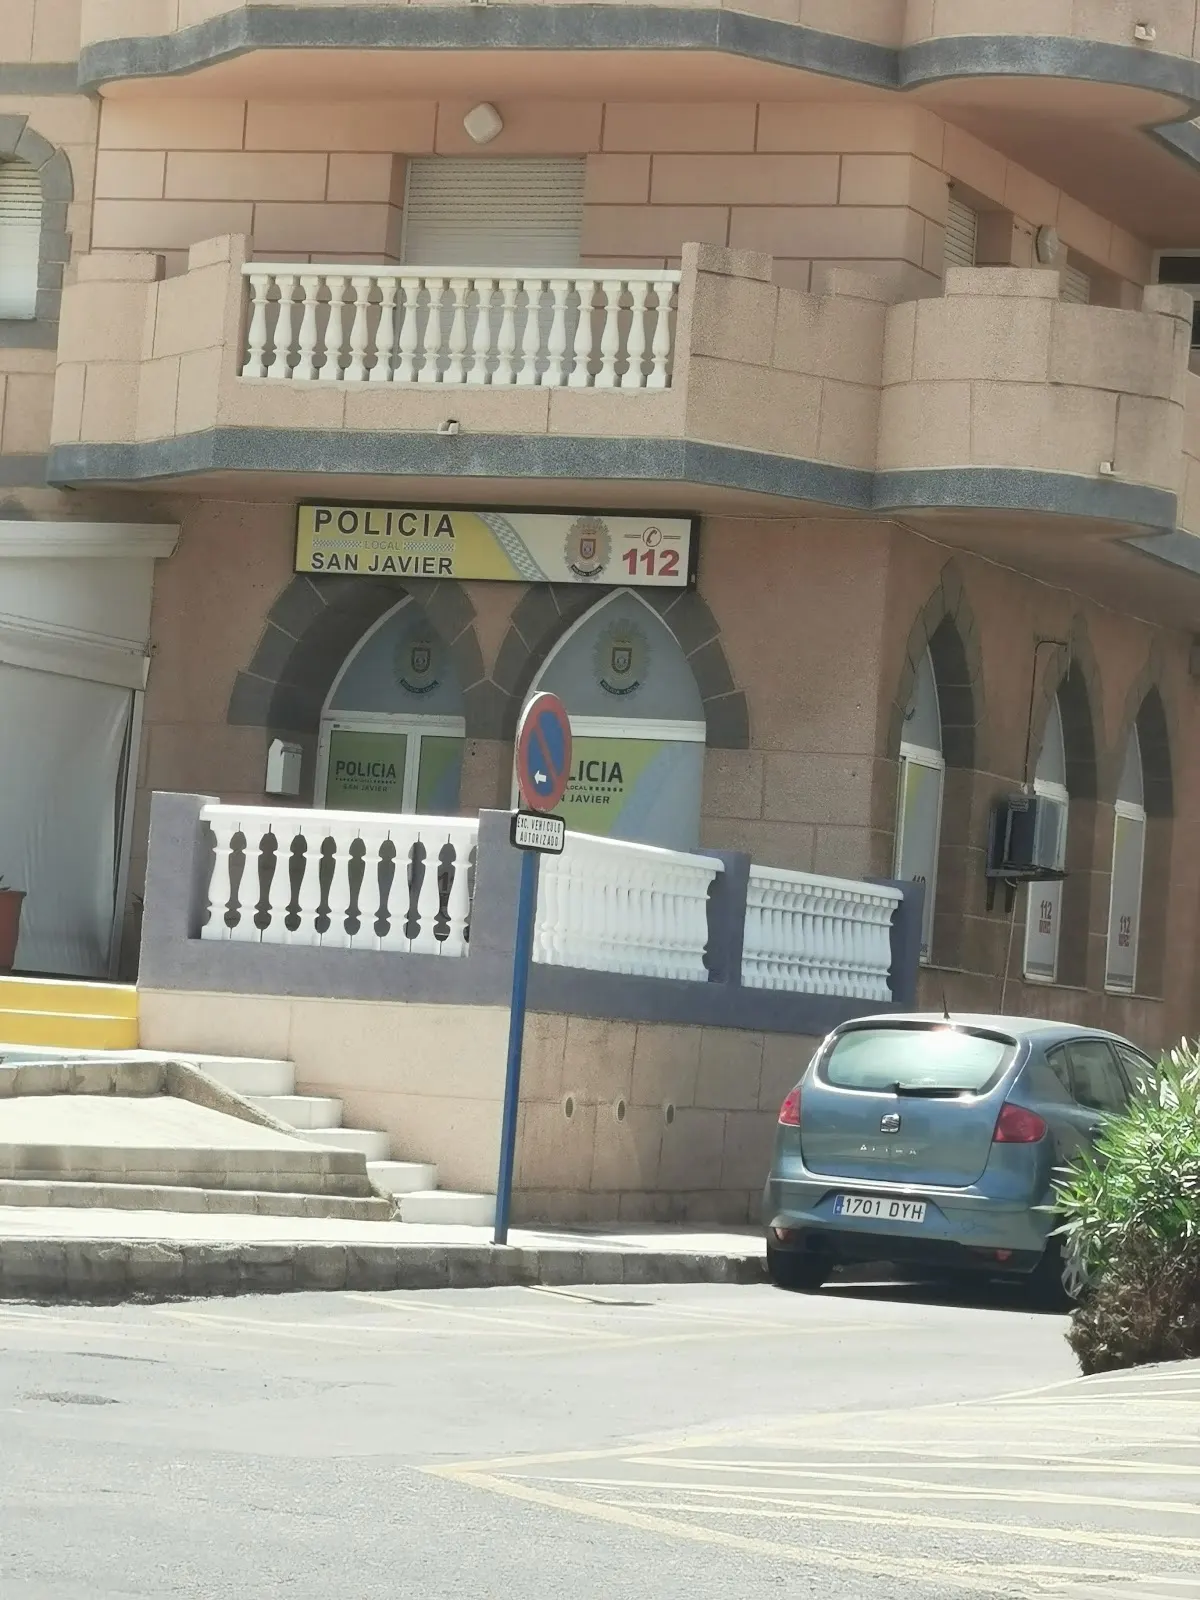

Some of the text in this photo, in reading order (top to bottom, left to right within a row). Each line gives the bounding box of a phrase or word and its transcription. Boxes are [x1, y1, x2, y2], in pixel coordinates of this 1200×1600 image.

[314, 509, 455, 538] POLICIA
[364, 540, 400, 551] LOCAL
[311, 552, 453, 575] SAN JAVIER
[622, 548, 680, 577] 112
[335, 760, 397, 779] POLICIA
[570, 794, 610, 804] JAVIER
[520, 831, 559, 847] AUTORIZADO
[1040, 899, 1053, 920] 112
[846, 1198, 923, 1220] 1701 DYH
